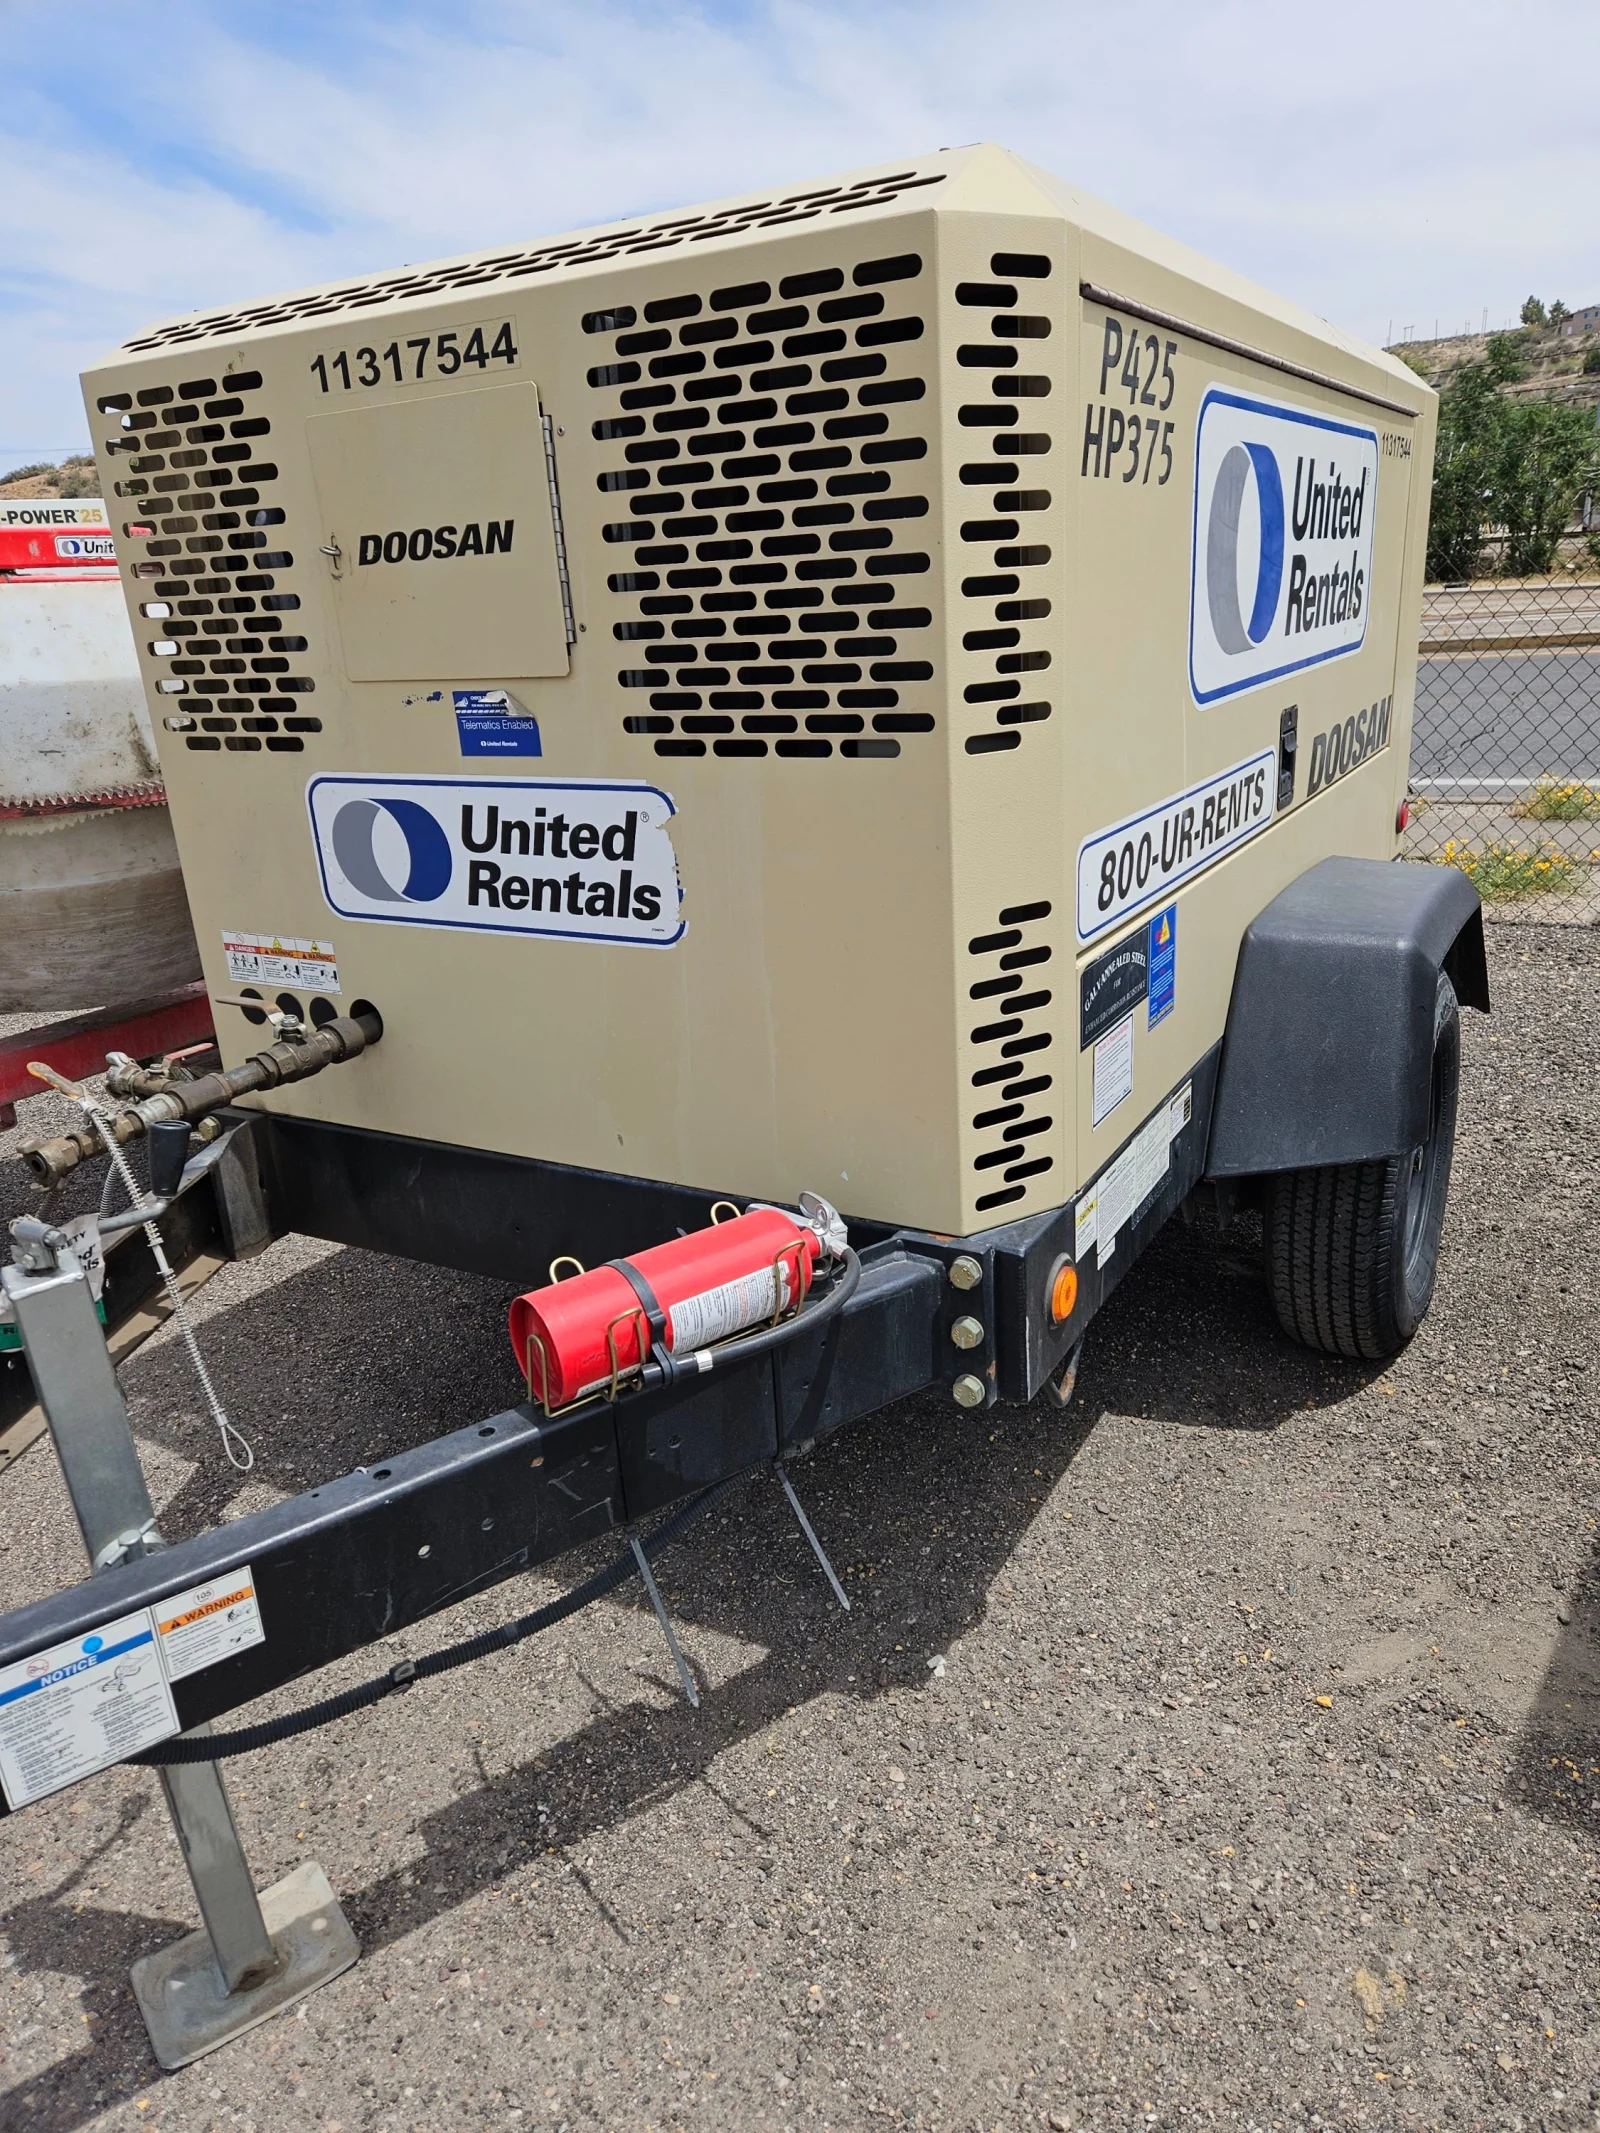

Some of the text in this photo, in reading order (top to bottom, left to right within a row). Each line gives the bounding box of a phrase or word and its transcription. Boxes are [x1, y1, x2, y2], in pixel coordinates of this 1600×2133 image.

[310, 322, 518, 393] 11317544
[1100, 316, 1177, 411] P425
[1081, 403, 1175, 486] HP375
[1381, 431, 1412, 460] 11317544
[1292, 455, 1367, 542] United
[0, 508, 103, 524] -POWER 25
[84, 541, 114, 554] Unit
[359, 519, 514, 566] DOOSAN
[1284, 550, 1364, 637] Rentals
[461, 719, 534, 730] Telematics Enabled
[1306, 693, 1393, 798] DOOSAN
[461, 804, 638, 862] United
[1098, 767, 1265, 912] 800-UR-RENTS
[468, 859, 662, 921] Rentals
[234, 945, 256, 953] DANGER
[270, 948, 294, 957] WARNING
[307, 953, 331, 962] WARNING
[1131, 951, 1146, 967] STEEL
[1112, 977, 1122, 990] FOR
[184, 1591, 245, 1622] WARNING
[196, 1590, 212, 1600] 105
[40, 1655, 98, 1687] NOTICE
